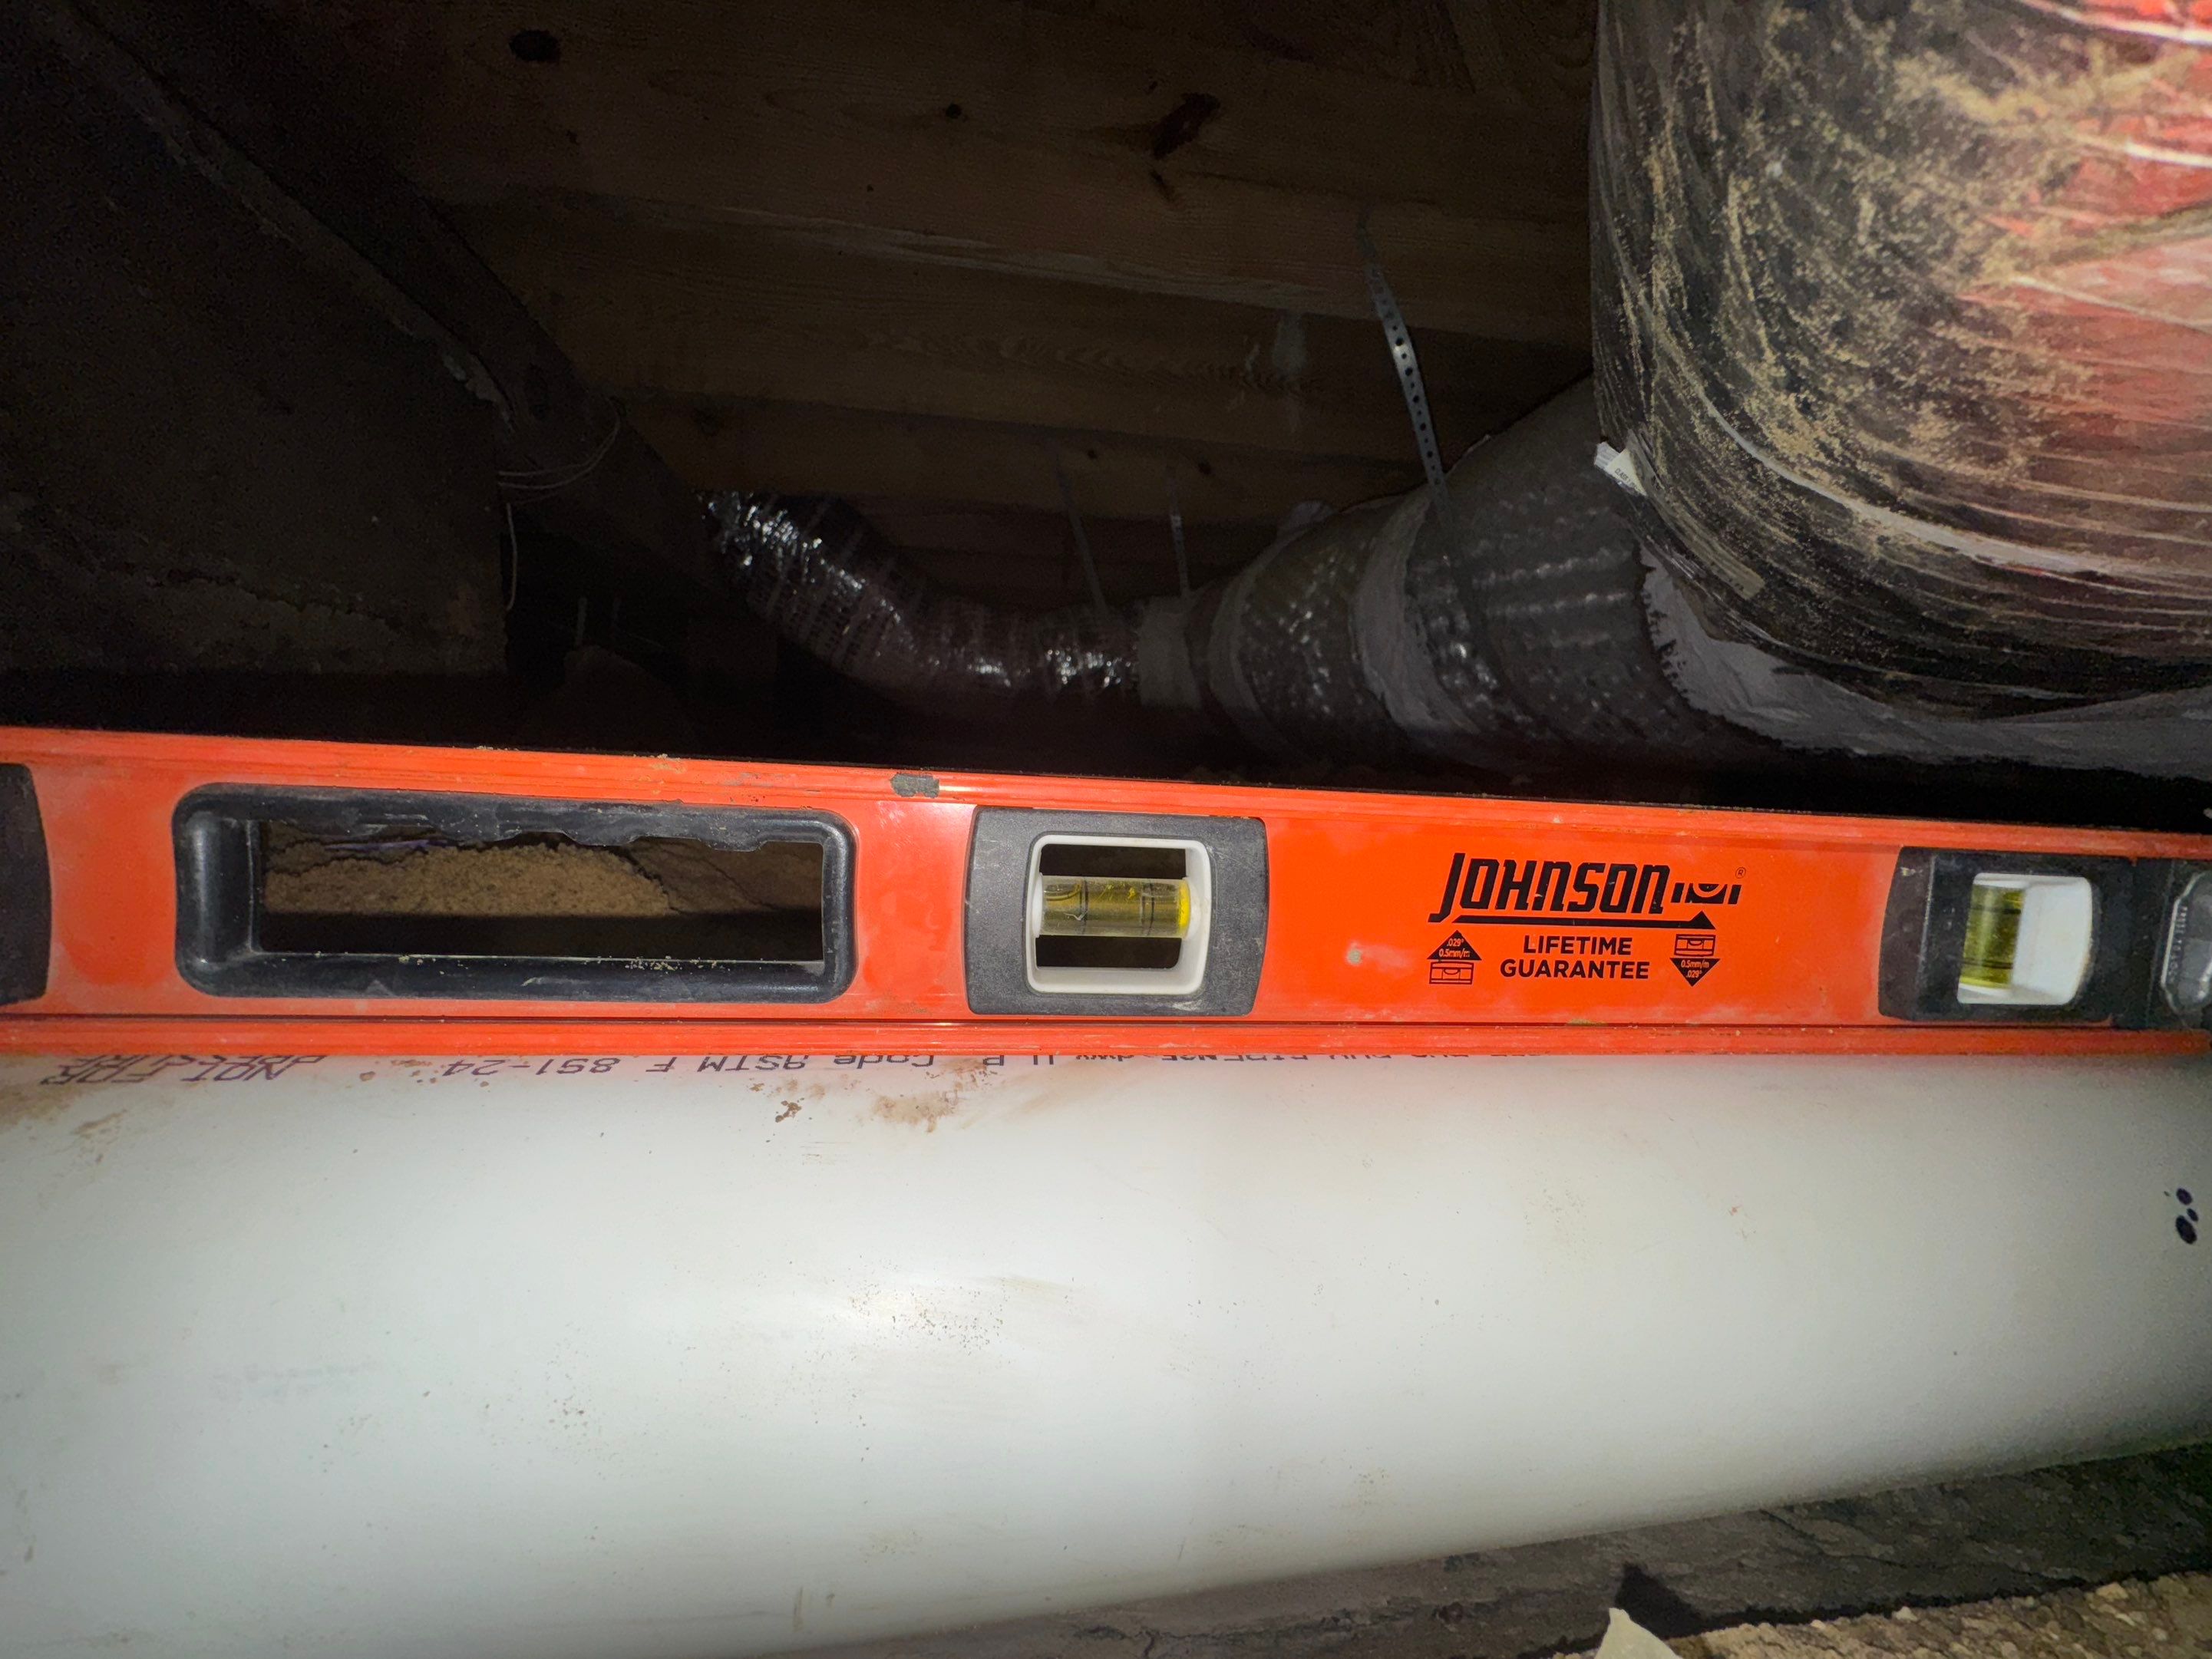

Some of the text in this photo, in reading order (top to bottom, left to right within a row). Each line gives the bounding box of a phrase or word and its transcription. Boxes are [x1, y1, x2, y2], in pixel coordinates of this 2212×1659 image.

[1428, 853, 1670, 923] JOHNSON
[1438, 948, 1471, 958] 0.5mm/m
[1523, 935, 1633, 955] LIFETIME
[1499, 958, 1650, 980] GUARANTEE
[1680, 959, 1710, 969] 0.5mm/m
[645, 1056, 677, 1073] F
[697, 1054, 808, 1073] ASTM
[833, 1054, 934, 1069] Code
[40, 1062, 295, 1086] NOT FOR
